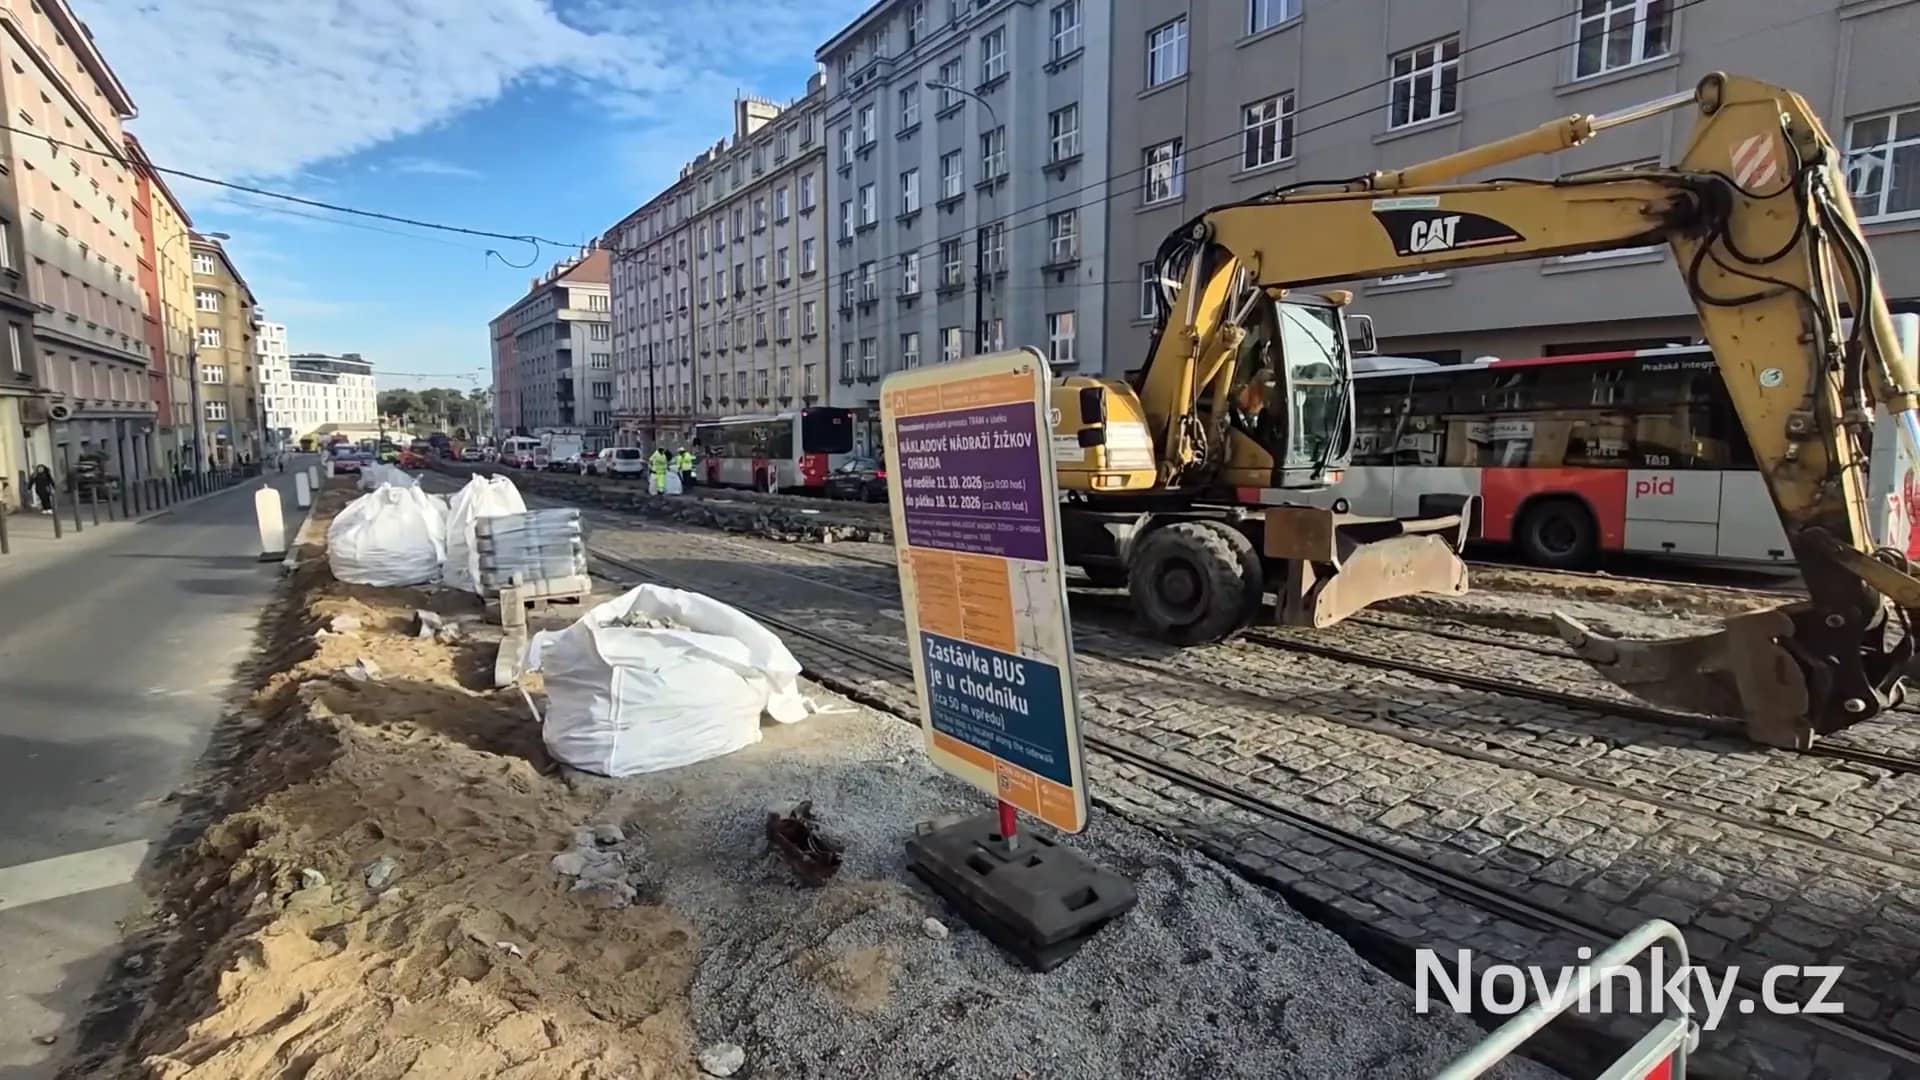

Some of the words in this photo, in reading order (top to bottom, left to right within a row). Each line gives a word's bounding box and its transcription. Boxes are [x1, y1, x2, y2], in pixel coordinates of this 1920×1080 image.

[1410, 215, 1462, 252] CAT
[899, 434, 949, 454] NÁKLADOVÉ
[949, 431, 991, 451] NÁDRAŽÍ
[993, 429, 1032, 449] ŽIŽKOV
[907, 455, 942, 470] OHRADA
[936, 476, 948, 489] 11.
[948, 475, 961, 489] 10.
[961, 475, 983, 489] 2026
[1636, 476, 1674, 499] pid
[947, 495, 960, 508] 12.
[960, 495, 981, 510] 2026
[927, 637, 990, 675] Zastávka
[992, 655, 1026, 687] BUS
[929, 662, 943, 688] je
[945, 672, 956, 690] u
[960, 674, 1029, 716] chodníku
[948, 695, 960, 711] 50
[960, 703, 970, 715] m
[970, 705, 1005, 732] vpředu)
